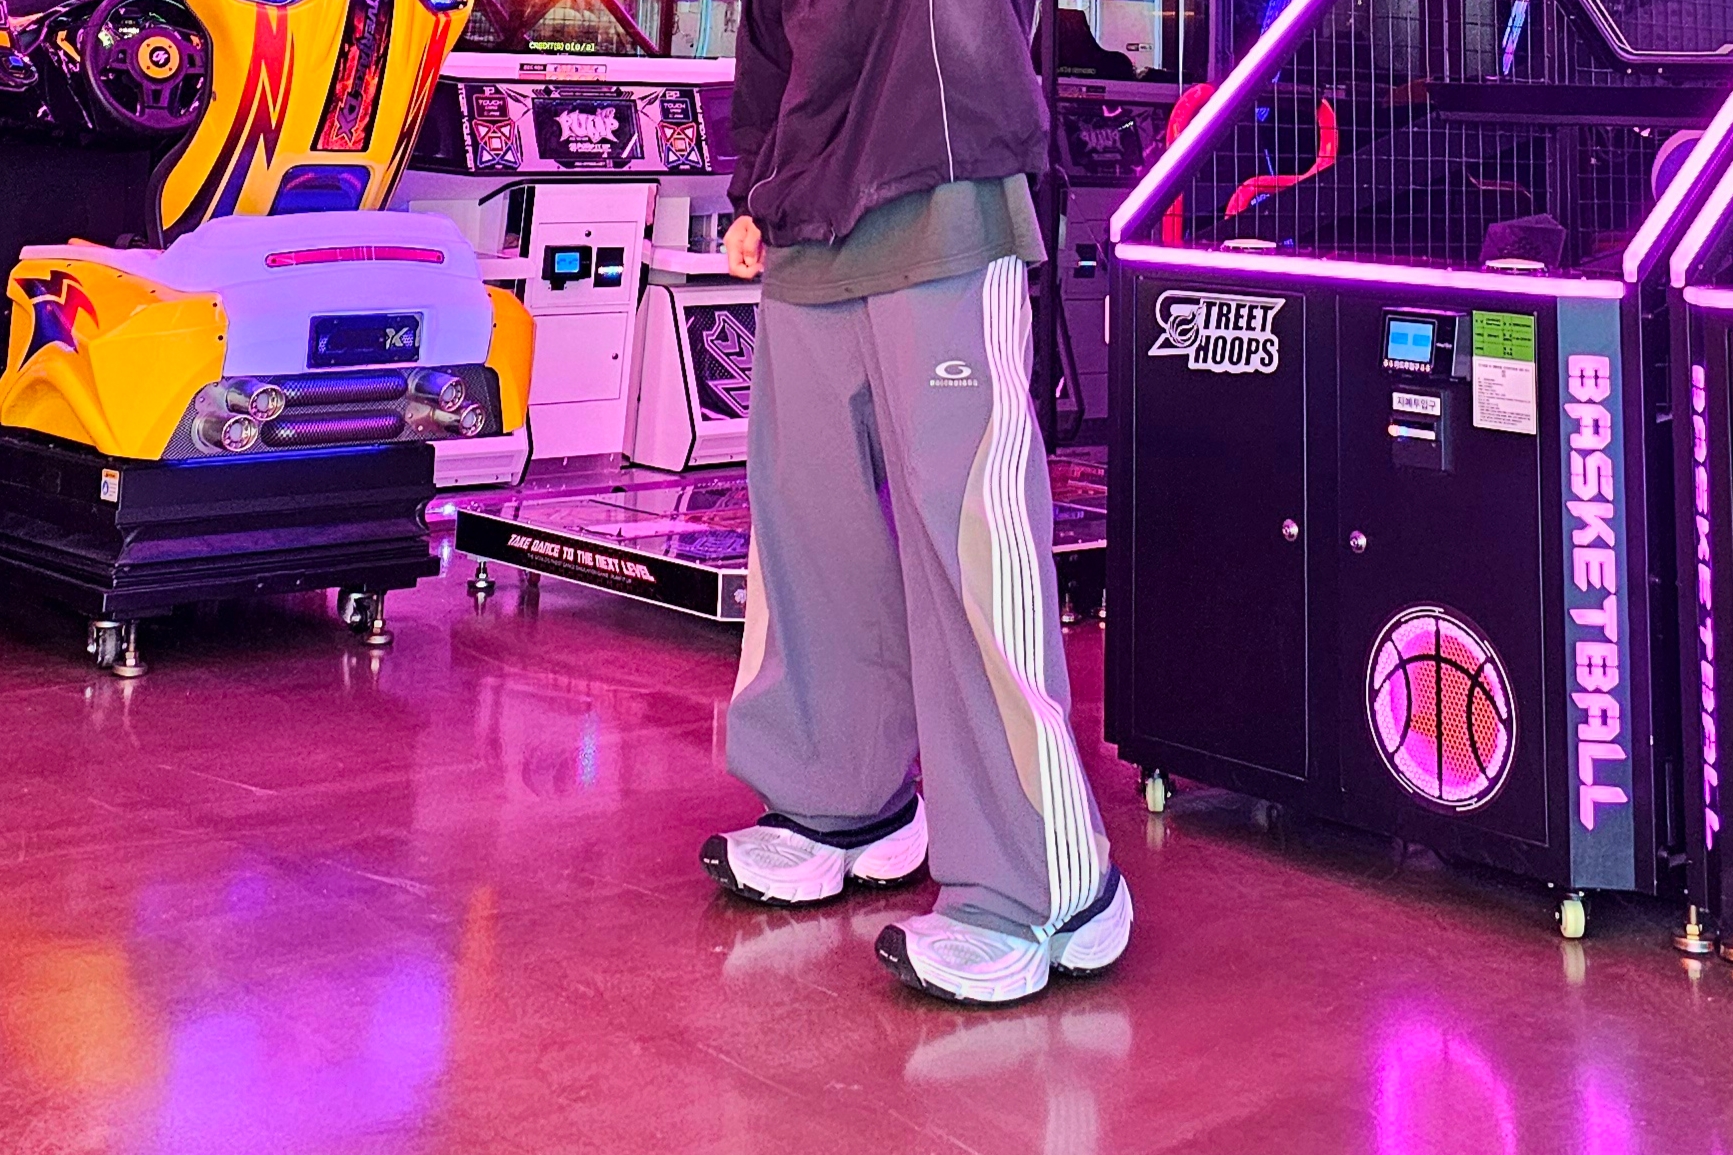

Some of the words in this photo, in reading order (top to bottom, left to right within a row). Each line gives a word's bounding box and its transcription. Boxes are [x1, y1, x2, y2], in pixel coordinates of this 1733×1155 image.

[1157, 295, 1277, 350] STREET
[1194, 334, 1275, 367] HOOPS
[1397, 396, 1436, 412] 지폐투입구
[507, 533, 533, 550] TAKE
[530, 539, 561, 559] DANCE
[562, 546, 575, 562] TO
[577, 550, 594, 566] THE
[595, 554, 621, 573] NEXT
[1563, 354, 1628, 831] BASKETBALL
[1692, 364, 1720, 851] BASKETBALL
